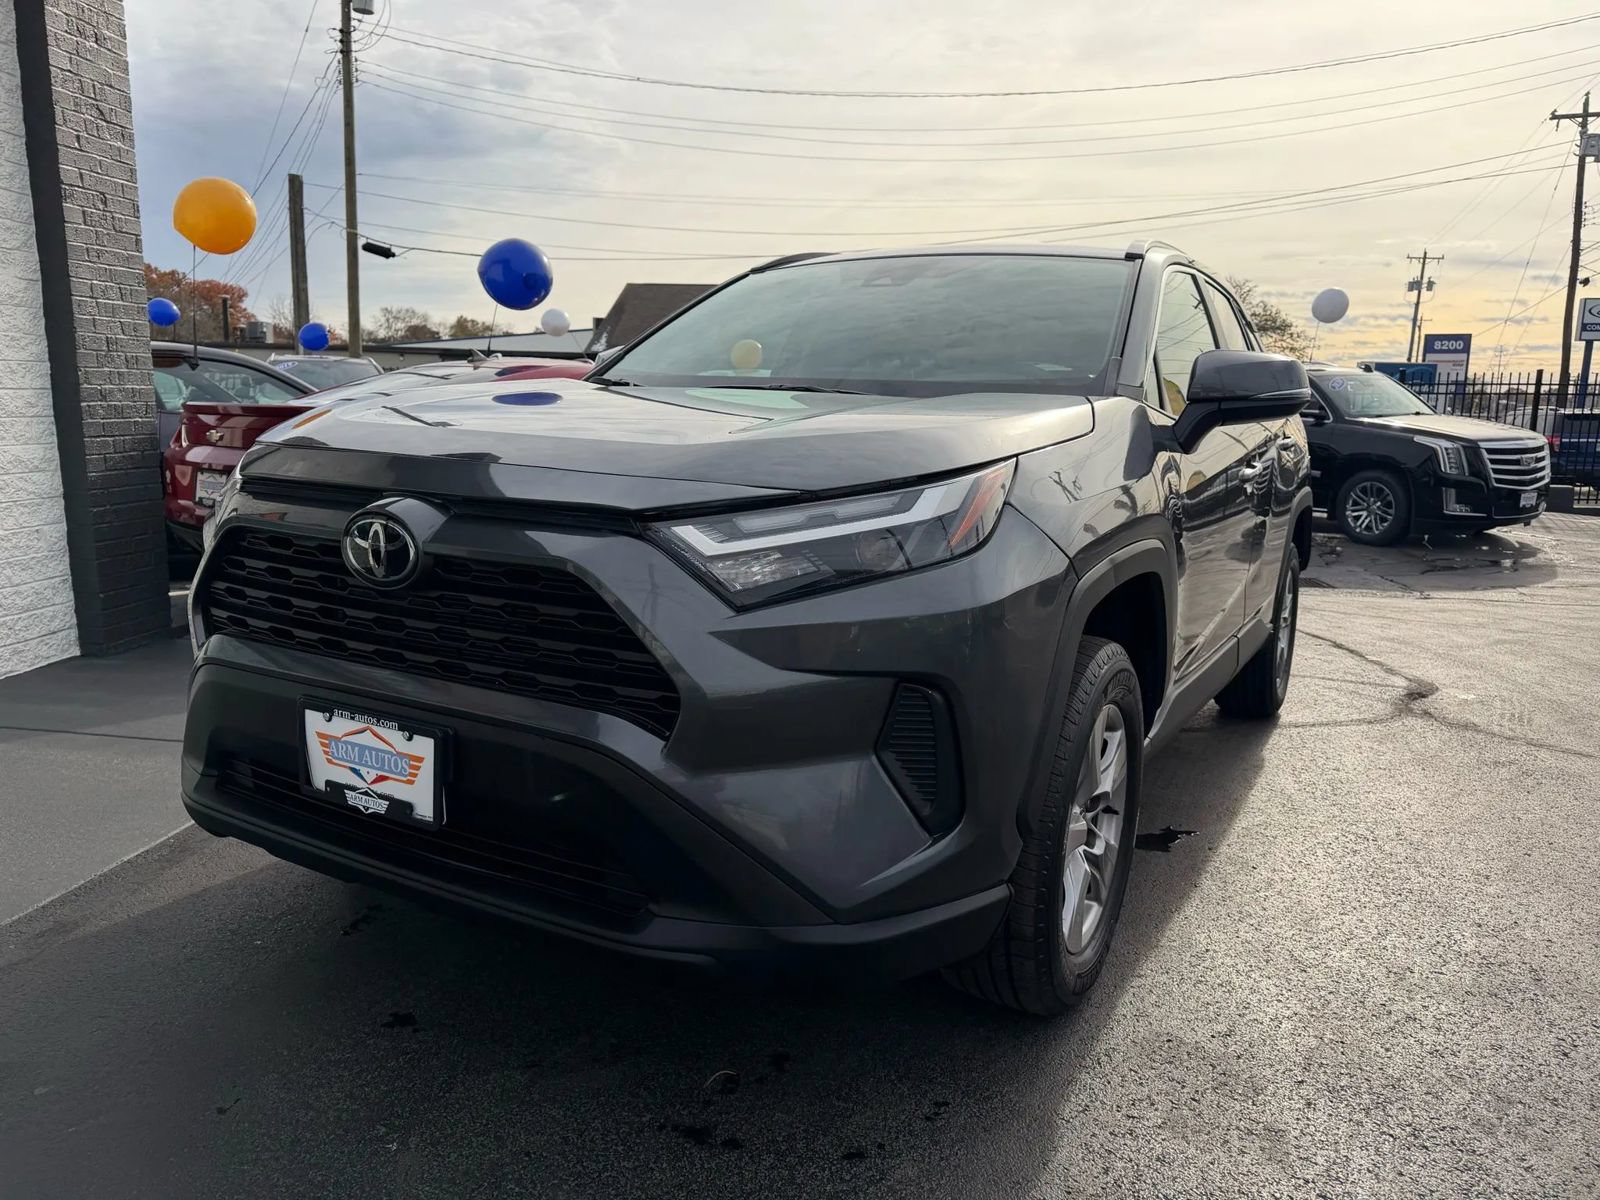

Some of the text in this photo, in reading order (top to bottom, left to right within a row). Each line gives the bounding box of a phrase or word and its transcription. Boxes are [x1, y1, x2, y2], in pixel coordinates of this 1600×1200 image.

[1433, 340, 1464, 350] 8200
[333, 708, 399, 731] arm-autos.com
[329, 741, 410, 775] ARM AUTOS
[349, 794, 384, 809] ARM AUTOS
